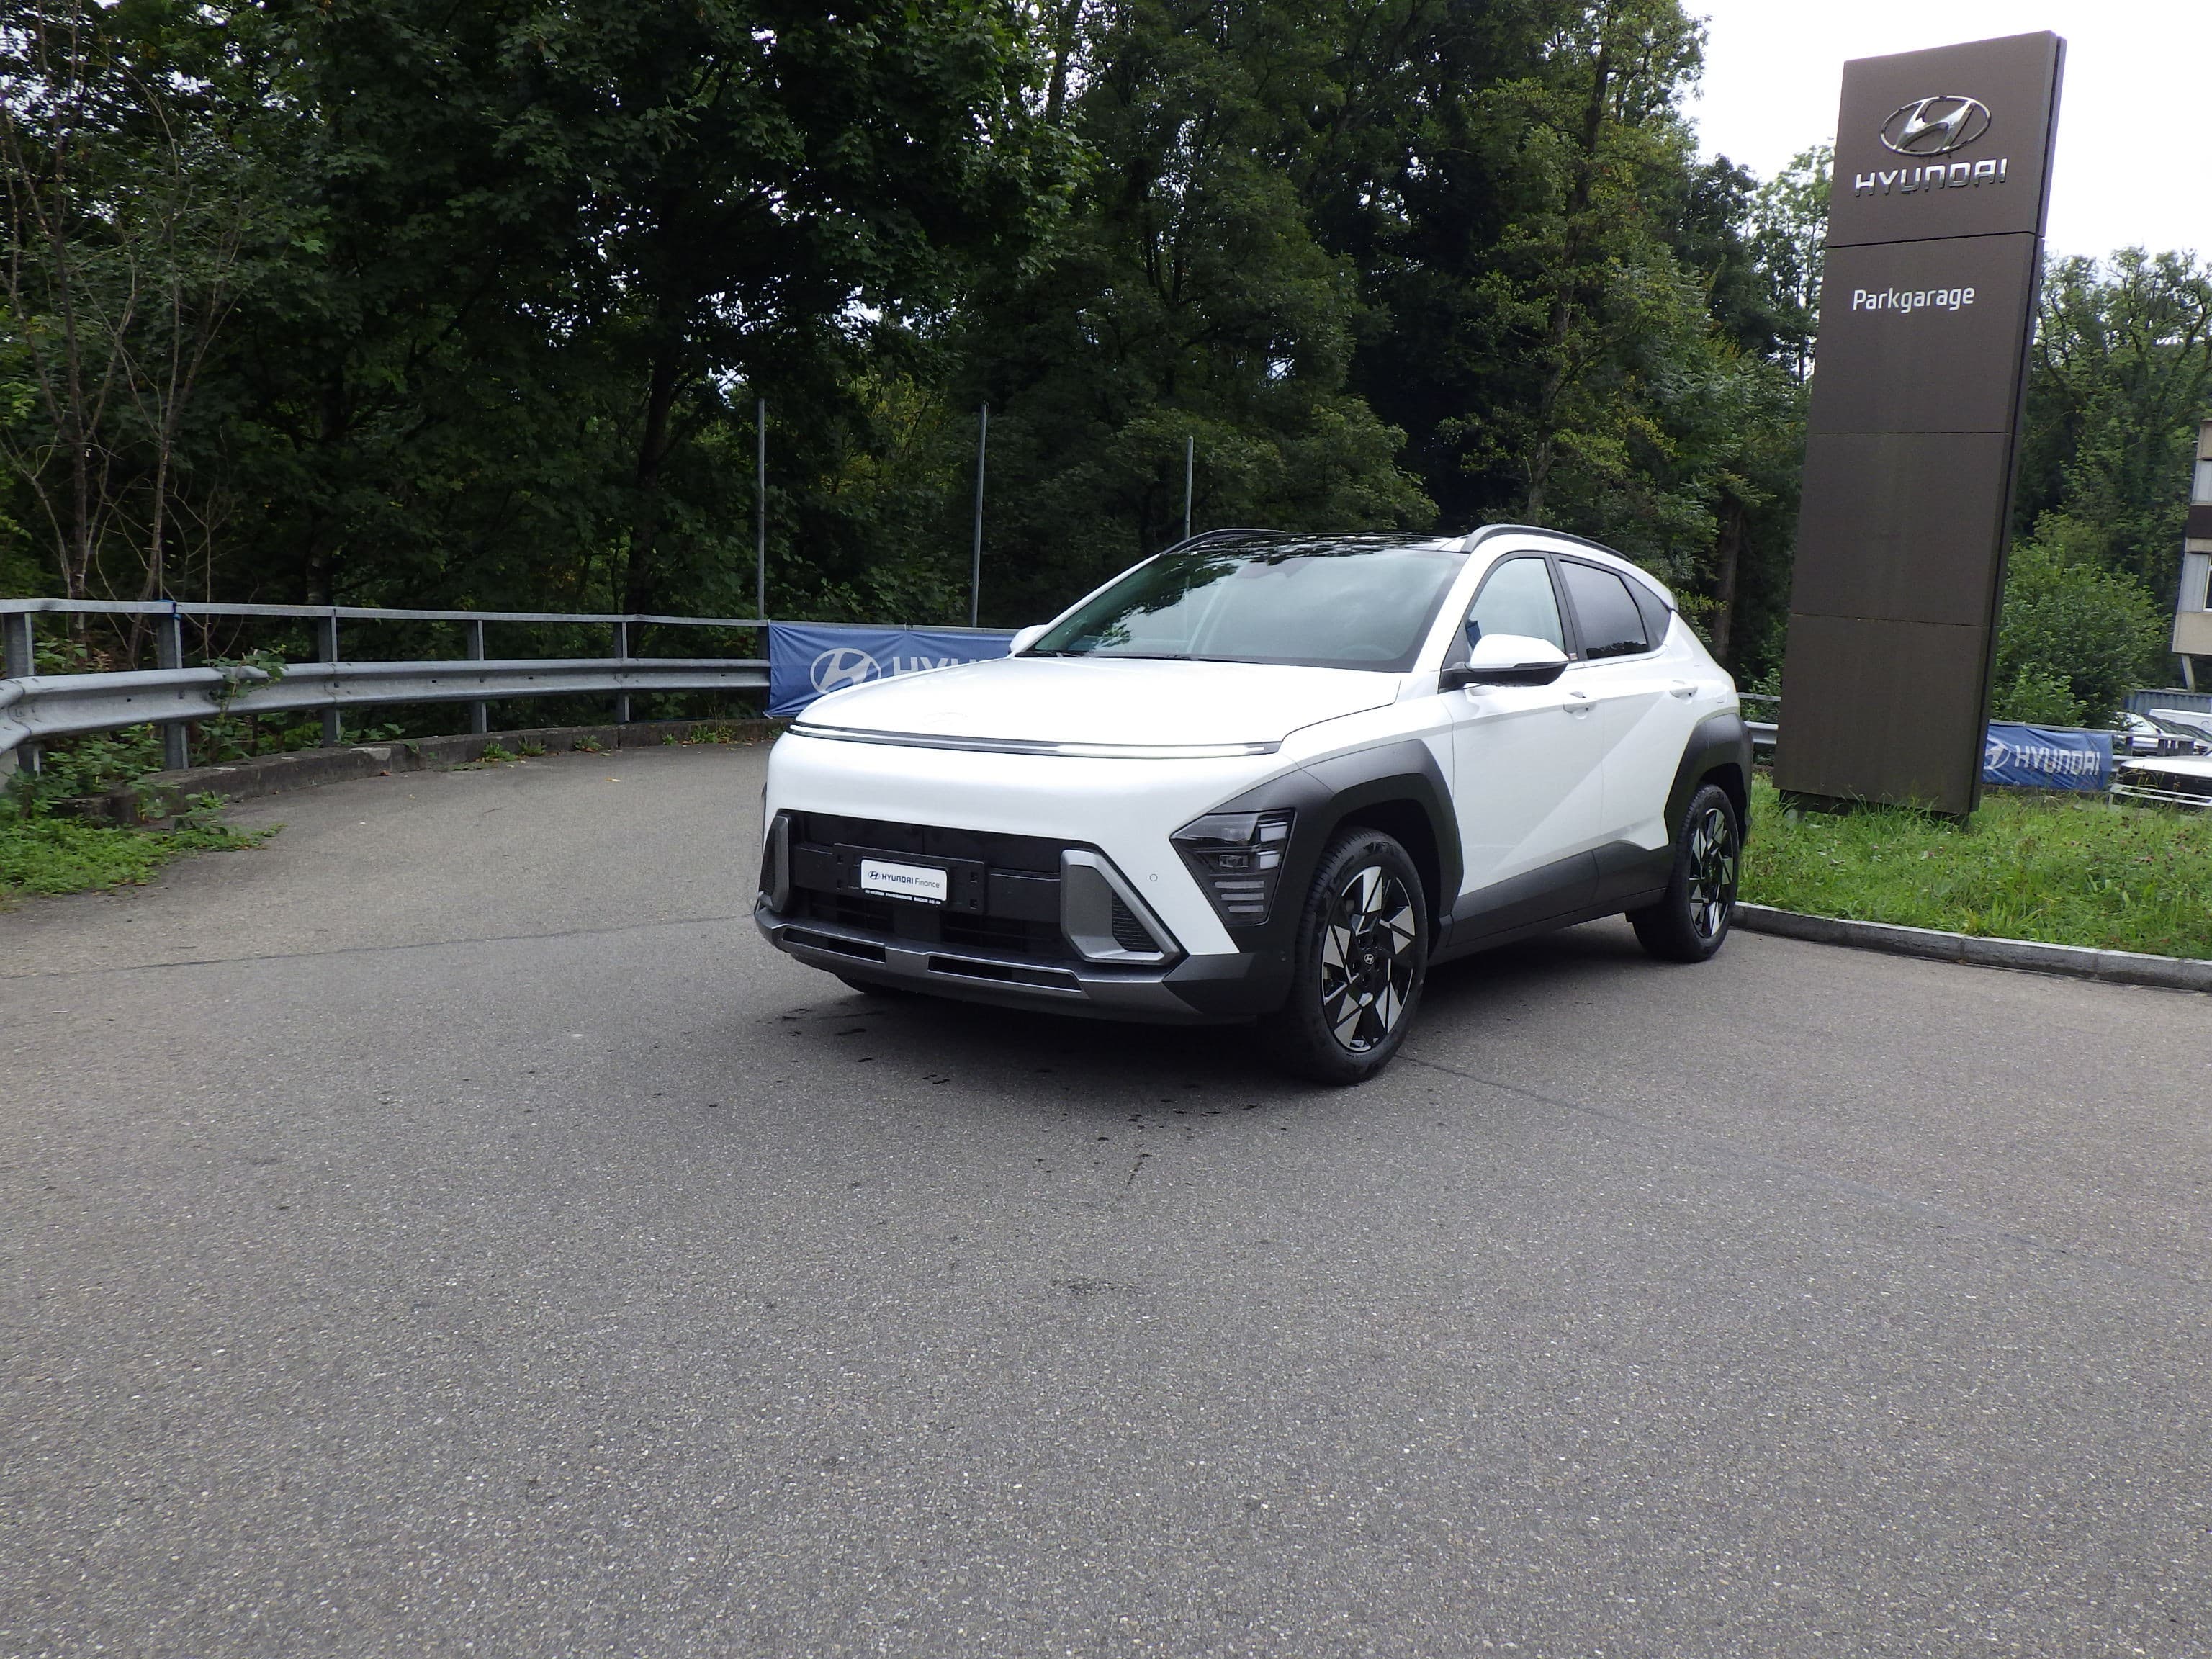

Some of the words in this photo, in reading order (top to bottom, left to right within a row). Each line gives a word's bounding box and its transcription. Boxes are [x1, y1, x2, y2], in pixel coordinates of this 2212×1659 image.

[1854, 158, 2008, 197] HYUNDAI
[1852, 287, 1975, 313] Parkgarage
[2014, 745, 2100, 775] HYUNDAI
[881, 873, 914, 884] HYUNDAI
[914, 878, 940, 888] Finance
